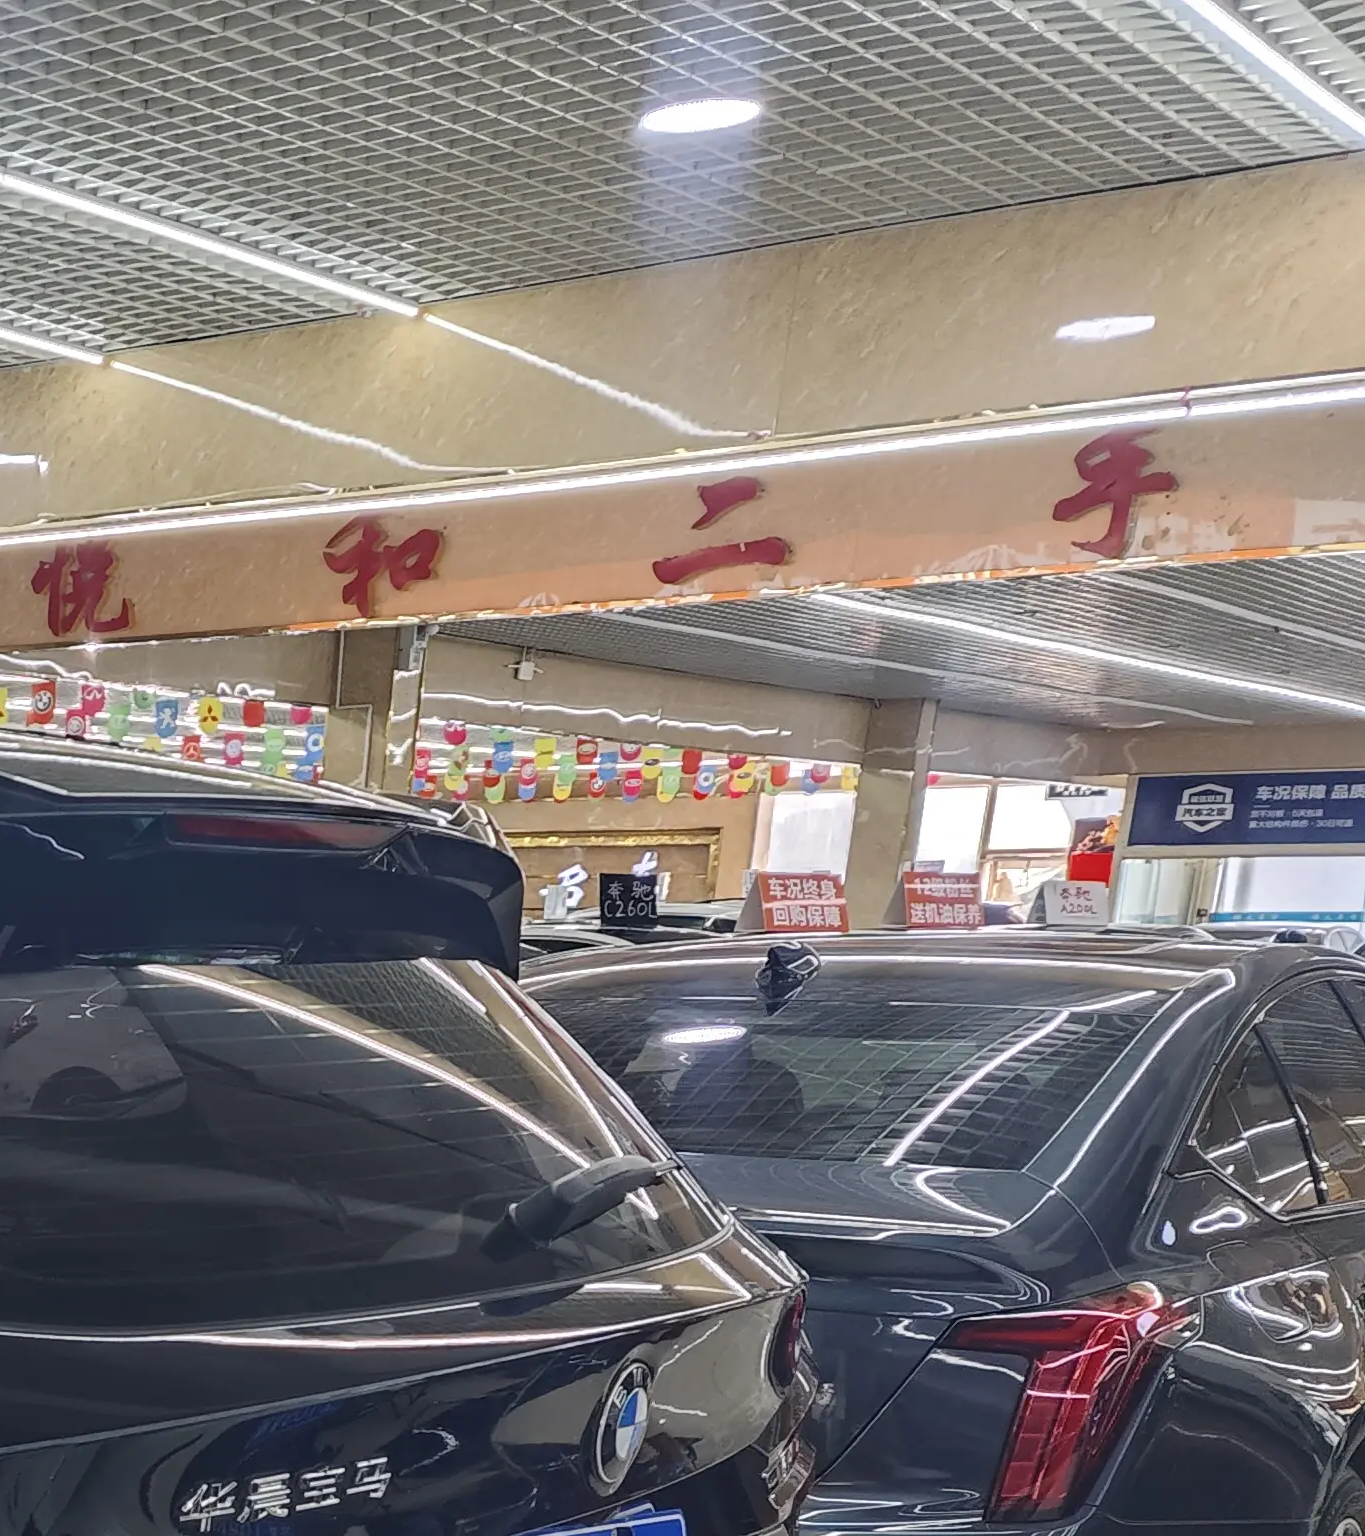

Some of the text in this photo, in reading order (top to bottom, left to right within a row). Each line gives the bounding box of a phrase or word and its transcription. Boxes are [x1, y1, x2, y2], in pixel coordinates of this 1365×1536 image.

[1255, 784, 1327, 801] 车况保障
[1182, 807, 1228, 818] 汽车之家
[607, 881, 655, 900] 奔驰
[768, 877, 837, 900] 车况终身
[603, 900, 658, 919] C260L
[772, 904, 842, 928] 回购保障
[910, 902, 982, 925] 送机油保养
[180, 1456, 392, 1532] 华晨宝马
